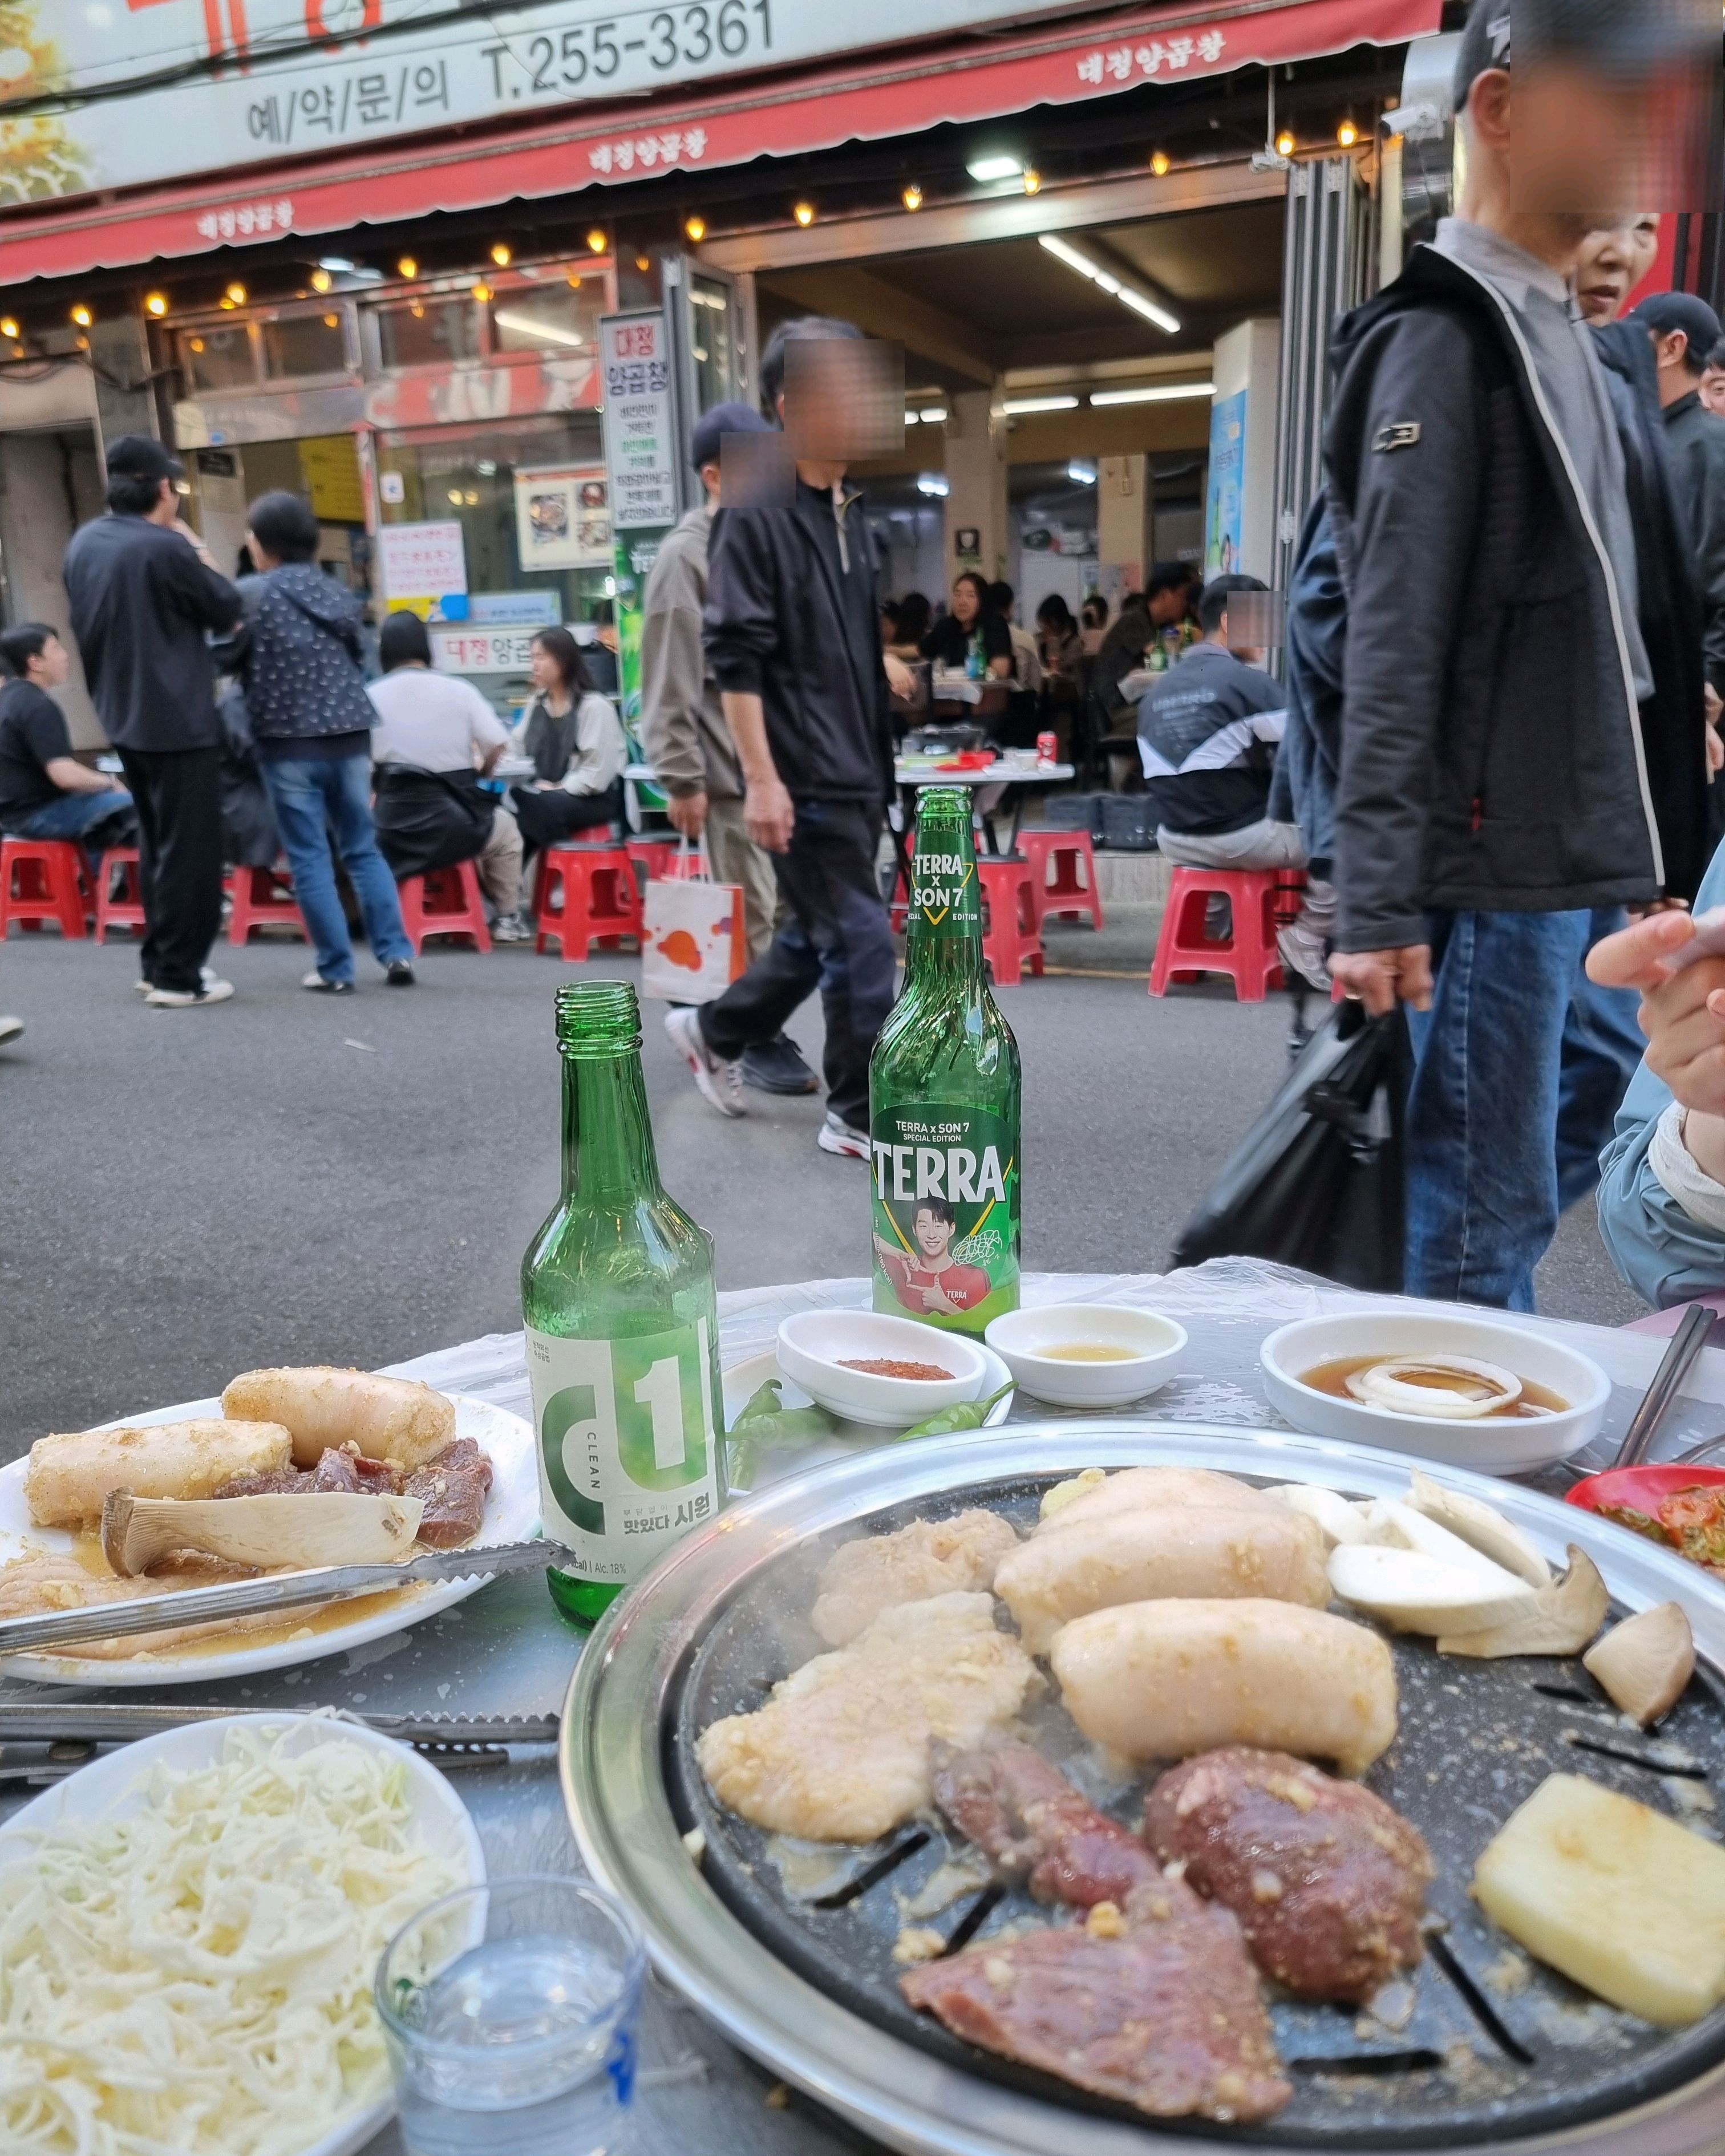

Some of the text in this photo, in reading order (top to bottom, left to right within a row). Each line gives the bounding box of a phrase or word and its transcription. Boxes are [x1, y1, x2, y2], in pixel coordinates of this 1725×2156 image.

[248, 60, 449, 144] 예/약/문/의
[481, 0, 772, 99] T.255-3361
[608, 362, 669, 396] 양곱창
[915, 854, 963, 876] TERRA
[914, 888, 963, 907] SON 7
[896, 1121, 928, 1133] TERRA
[938, 1123, 961, 1133] SON
[963, 1122, 970, 1132] 7
[873, 1140, 1006, 1202] TERRA
[946, 1290, 967, 1299] TERRA
[587, 1432, 601, 1489] CLEAN
[624, 1492, 710, 1534] 맛있다 시원
[595, 1562, 609, 1574] Alc.
[610, 1563, 627, 1574] 18%
